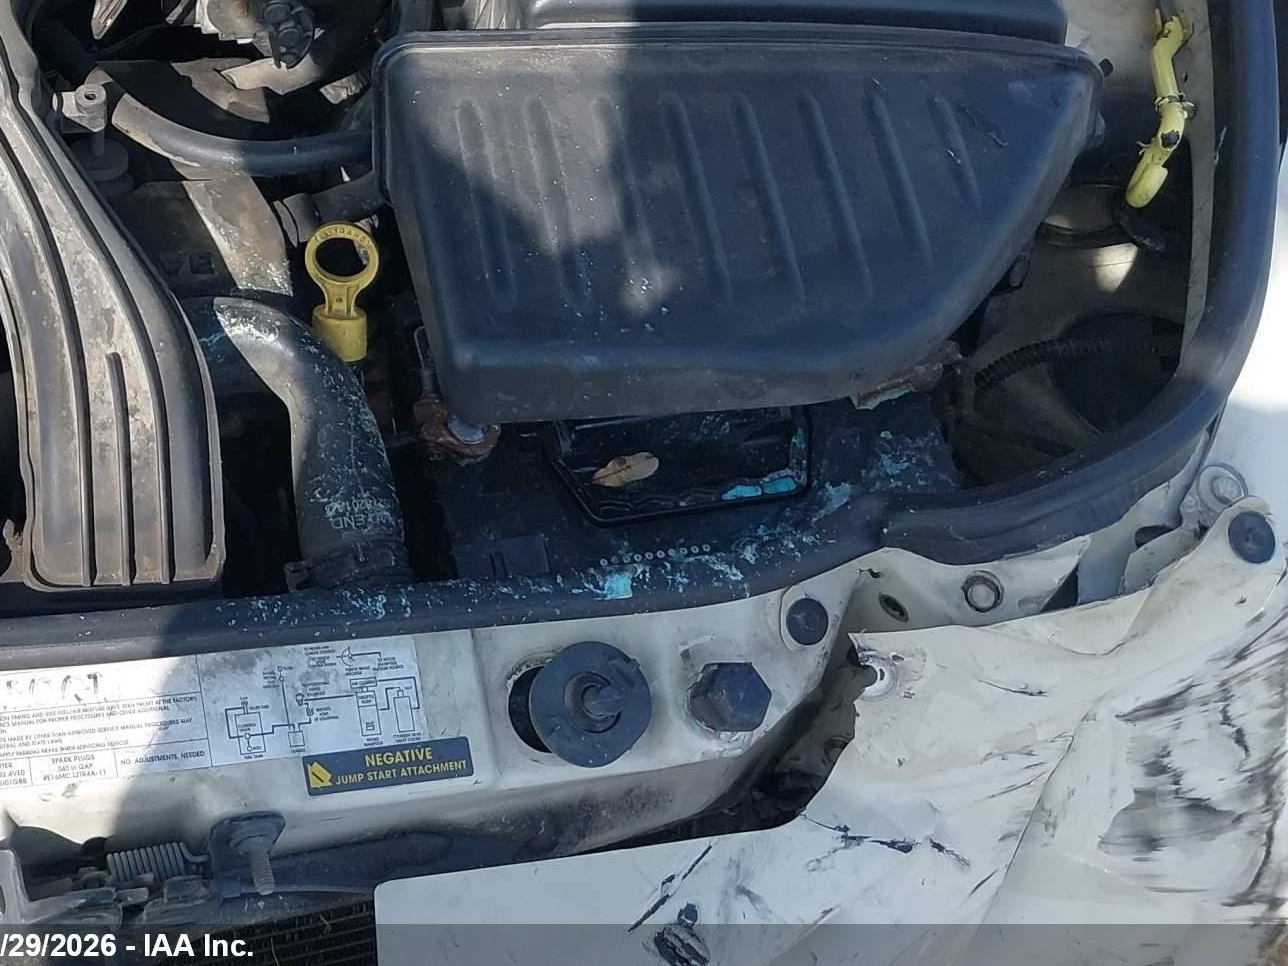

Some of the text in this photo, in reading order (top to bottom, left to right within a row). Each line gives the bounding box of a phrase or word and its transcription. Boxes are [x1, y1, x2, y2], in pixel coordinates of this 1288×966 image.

[74, 754, 95, 762] PLUGS
[134, 754, 178, 764] ADJUSTMENTS
[180, 750, 205, 759] NEEDED
[364, 747, 433, 767] NEGATIVE
[336, 760, 467, 786] JUMP START ATTACHMENT
